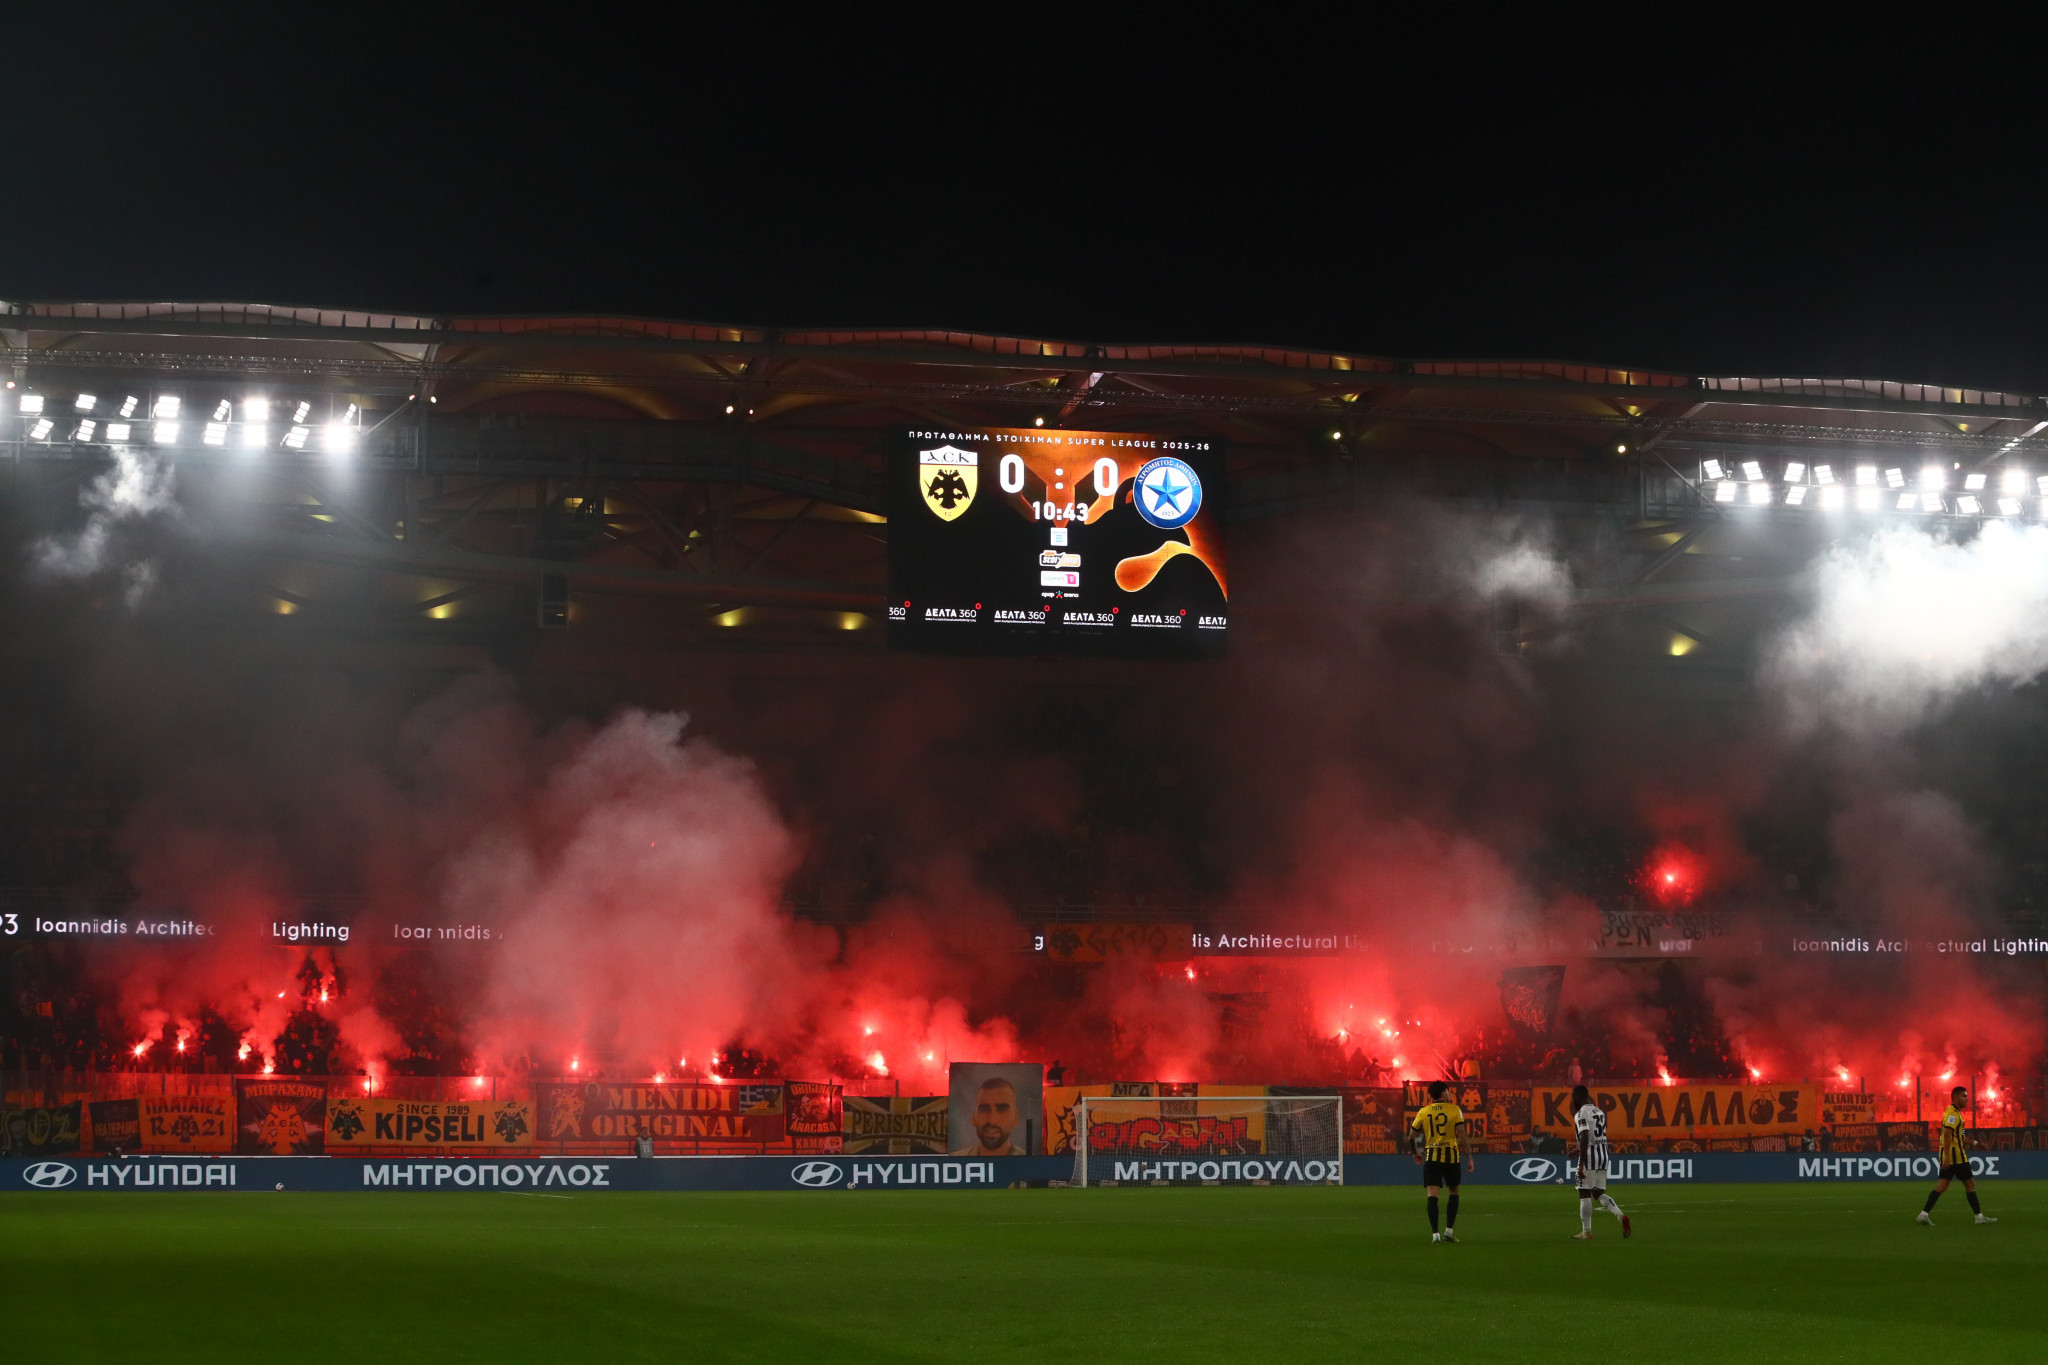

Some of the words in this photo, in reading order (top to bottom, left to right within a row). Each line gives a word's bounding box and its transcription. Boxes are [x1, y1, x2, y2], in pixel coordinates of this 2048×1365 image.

[908, 431, 990, 442] ΠΡΩΤΑΘΛΗΜΑ
[996, 435, 1062, 445] STOIXIMAN
[1068, 437, 1105, 446] SUPER
[1111, 440, 1156, 449] LEAGUE
[1162, 441, 1210, 450] 2025-26
[999, 453, 1025, 494] 0
[1093, 456, 1119, 497] 0
[1032, 501, 1089, 522] 10:43
[925, 608, 957, 618] ΔΕΛΤΑ
[958, 609, 977, 618] 360
[994, 610, 1026, 619] ΔΕΛΤΑ
[1027, 611, 1046, 620] 360
[1063, 612, 1095, 622] ΔΕΛΤΑ
[1096, 613, 1114, 623] 360
[1131, 614, 1163, 624] ΔΕΛΤΑ
[1164, 615, 1182, 624] 360
[272, 921, 350, 942] Lighting
[1217, 933, 1338, 950] Architectural
[1793, 937, 1869, 952] Ioannidis
[607, 1087, 734, 1112] MENIDI
[1487, 1089, 1530, 1099] SOUTH
[1823, 1093, 1875, 1105] ALIARTOS
[396, 1103, 439, 1115] SINCE
[446, 1105, 470, 1116] 1989
[1541, 1089, 1800, 1129] ΚΡΥΔΑΛΛΟΣ
[1842, 1112, 1857, 1122] 21
[201, 1118, 225, 1136] 21
[375, 1111, 485, 1142] KIPSELI
[591, 1114, 752, 1138] ORIGINAL
[1352, 1123, 1386, 1139] FREE
[1427, 1112, 1448, 1138] 12
[1493, 1124, 1524, 1134] SIDE
[1342, 1140, 1397, 1154] AMERICAN
[87, 1164, 237, 1186] HYUNDAI
[362, 1164, 610, 1187] ΜΗΤΡΟΠΟΥΛΟΣ
[853, 1162, 995, 1184] HYUNDAI
[1113, 1160, 1340, 1182] ΜΗΤΡΟΠΟΥΛΟΣ
[1565, 1158, 1693, 1180] HUNDAI
